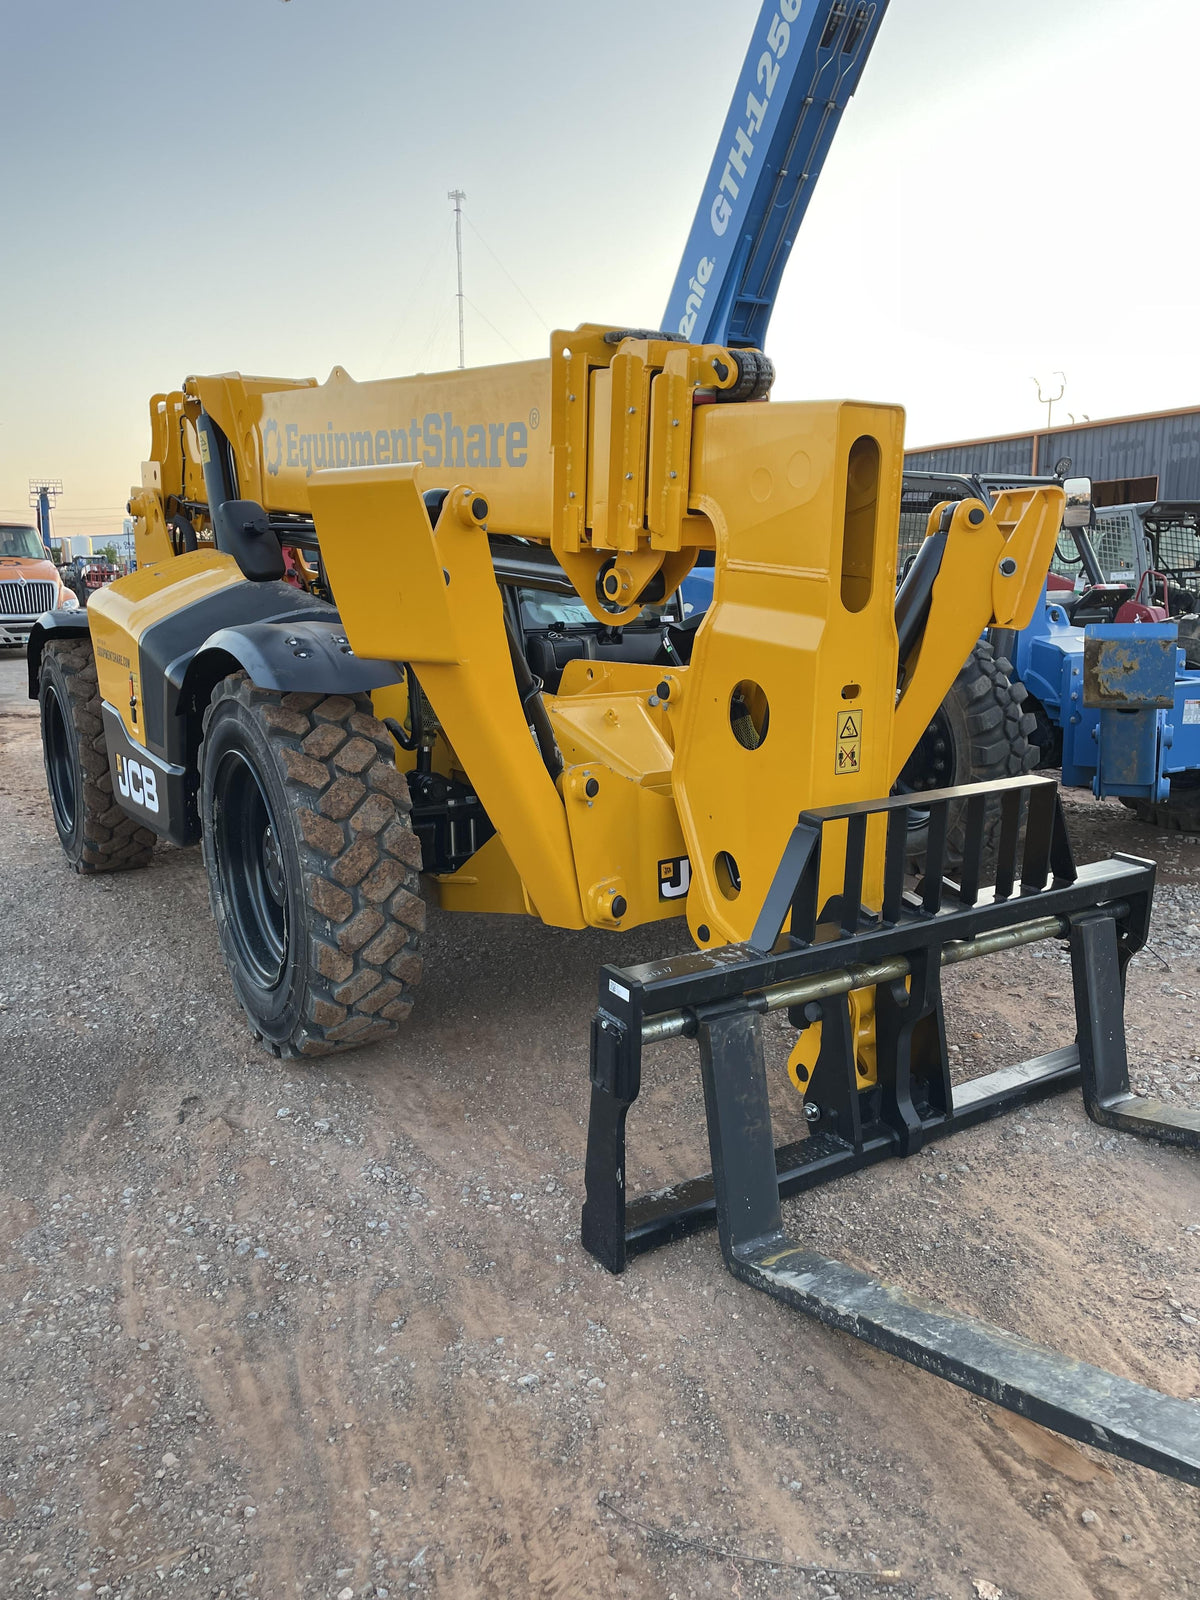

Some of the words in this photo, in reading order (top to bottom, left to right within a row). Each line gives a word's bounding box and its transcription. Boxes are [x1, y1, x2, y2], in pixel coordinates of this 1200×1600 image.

[711, 0, 802, 236] GTH-1256
[678, 256, 716, 341] enie
[118, 756, 159, 814] JCB
